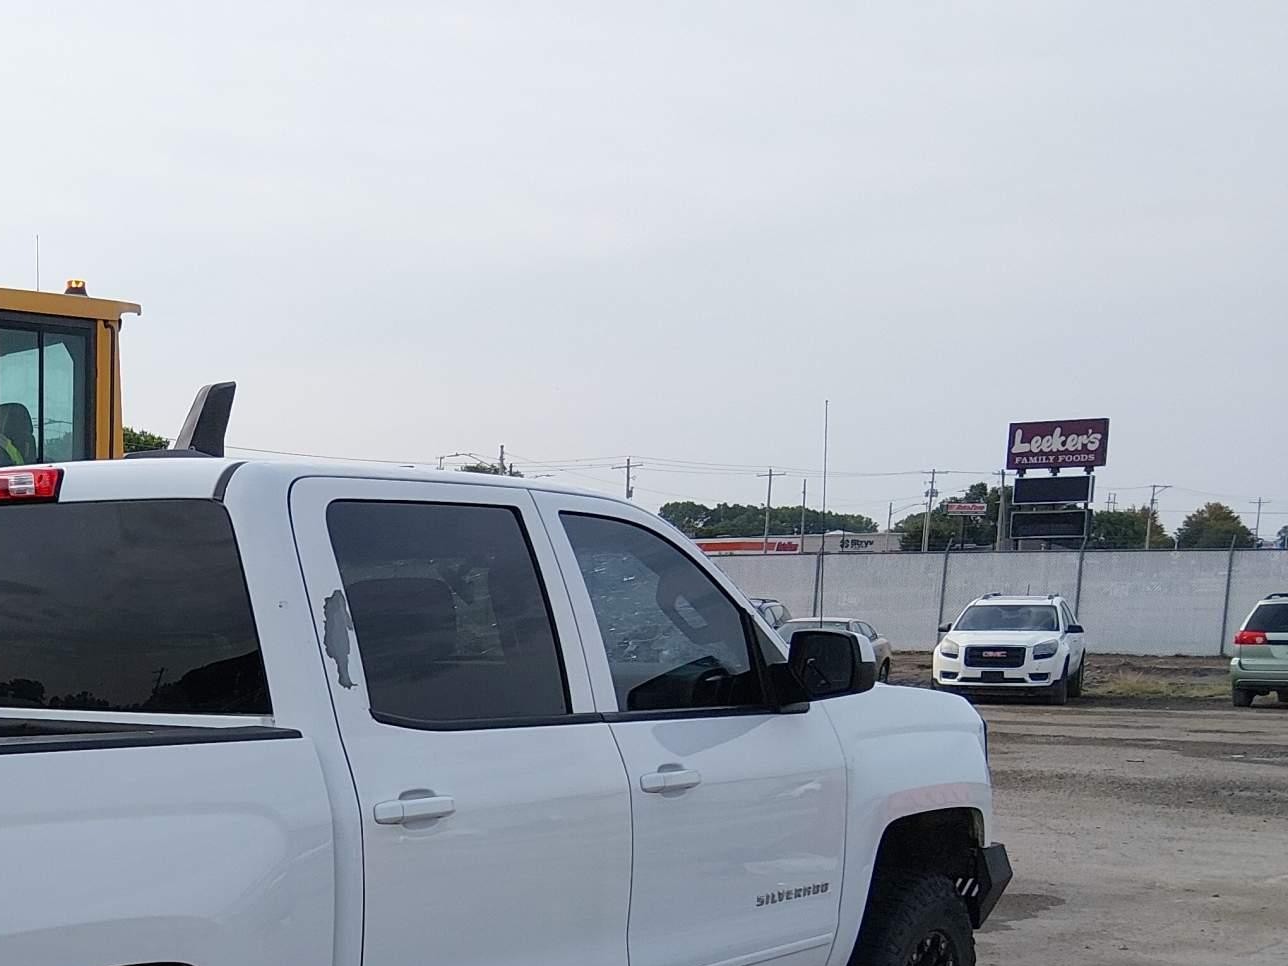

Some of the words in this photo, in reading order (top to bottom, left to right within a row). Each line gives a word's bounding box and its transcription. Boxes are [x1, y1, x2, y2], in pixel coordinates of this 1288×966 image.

[1011, 427, 1102, 453] Leeker's
[1015, 455, 1055, 464] FAMILY
[1058, 453, 1095, 462] FOODS
